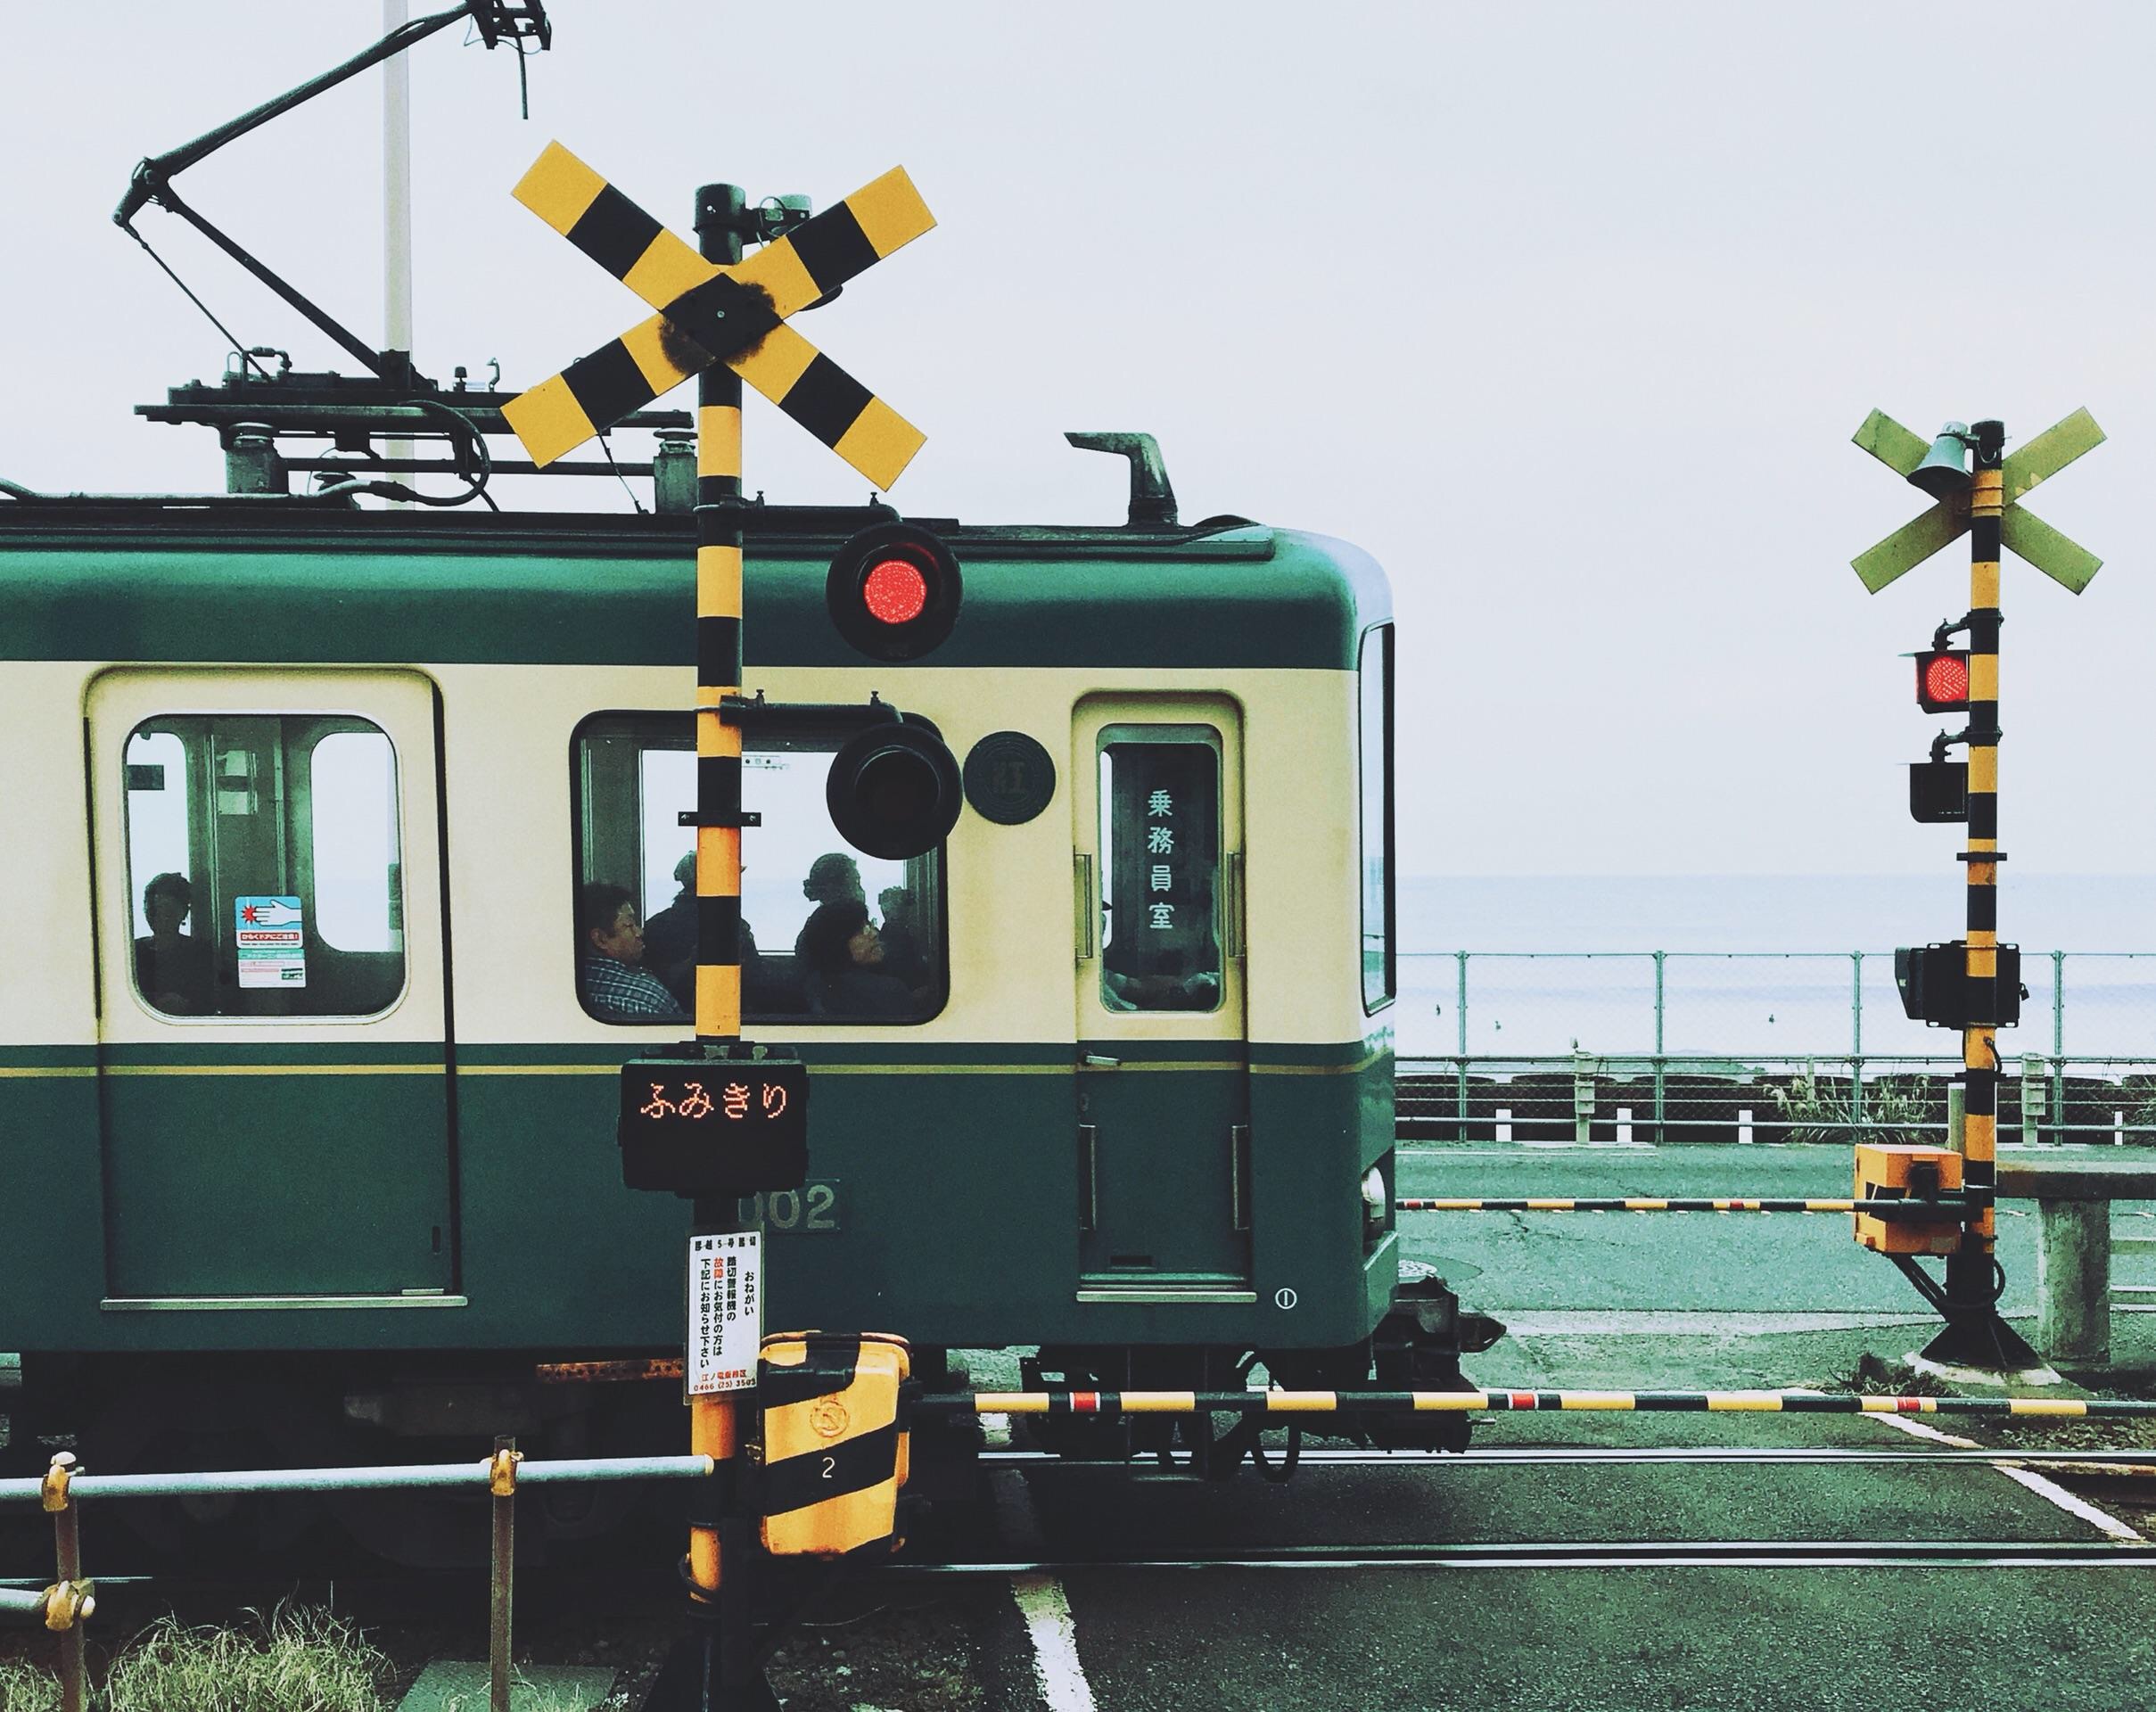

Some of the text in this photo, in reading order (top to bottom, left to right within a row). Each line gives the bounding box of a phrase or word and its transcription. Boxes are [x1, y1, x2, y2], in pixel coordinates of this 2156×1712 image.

[1148, 789, 1174, 929] 乗務員室
[640, 1082, 786, 1119] ふみきり
[700, 1258, 711, 1368] 下記にお知らせ下さい
[713, 1257, 723, 1356] 故障にお気付の方は
[727, 1255, 736, 1321] 踏切警報機の
[745, 1271, 754, 1315] おねがい
[822, 1456, 835, 1478] 2
